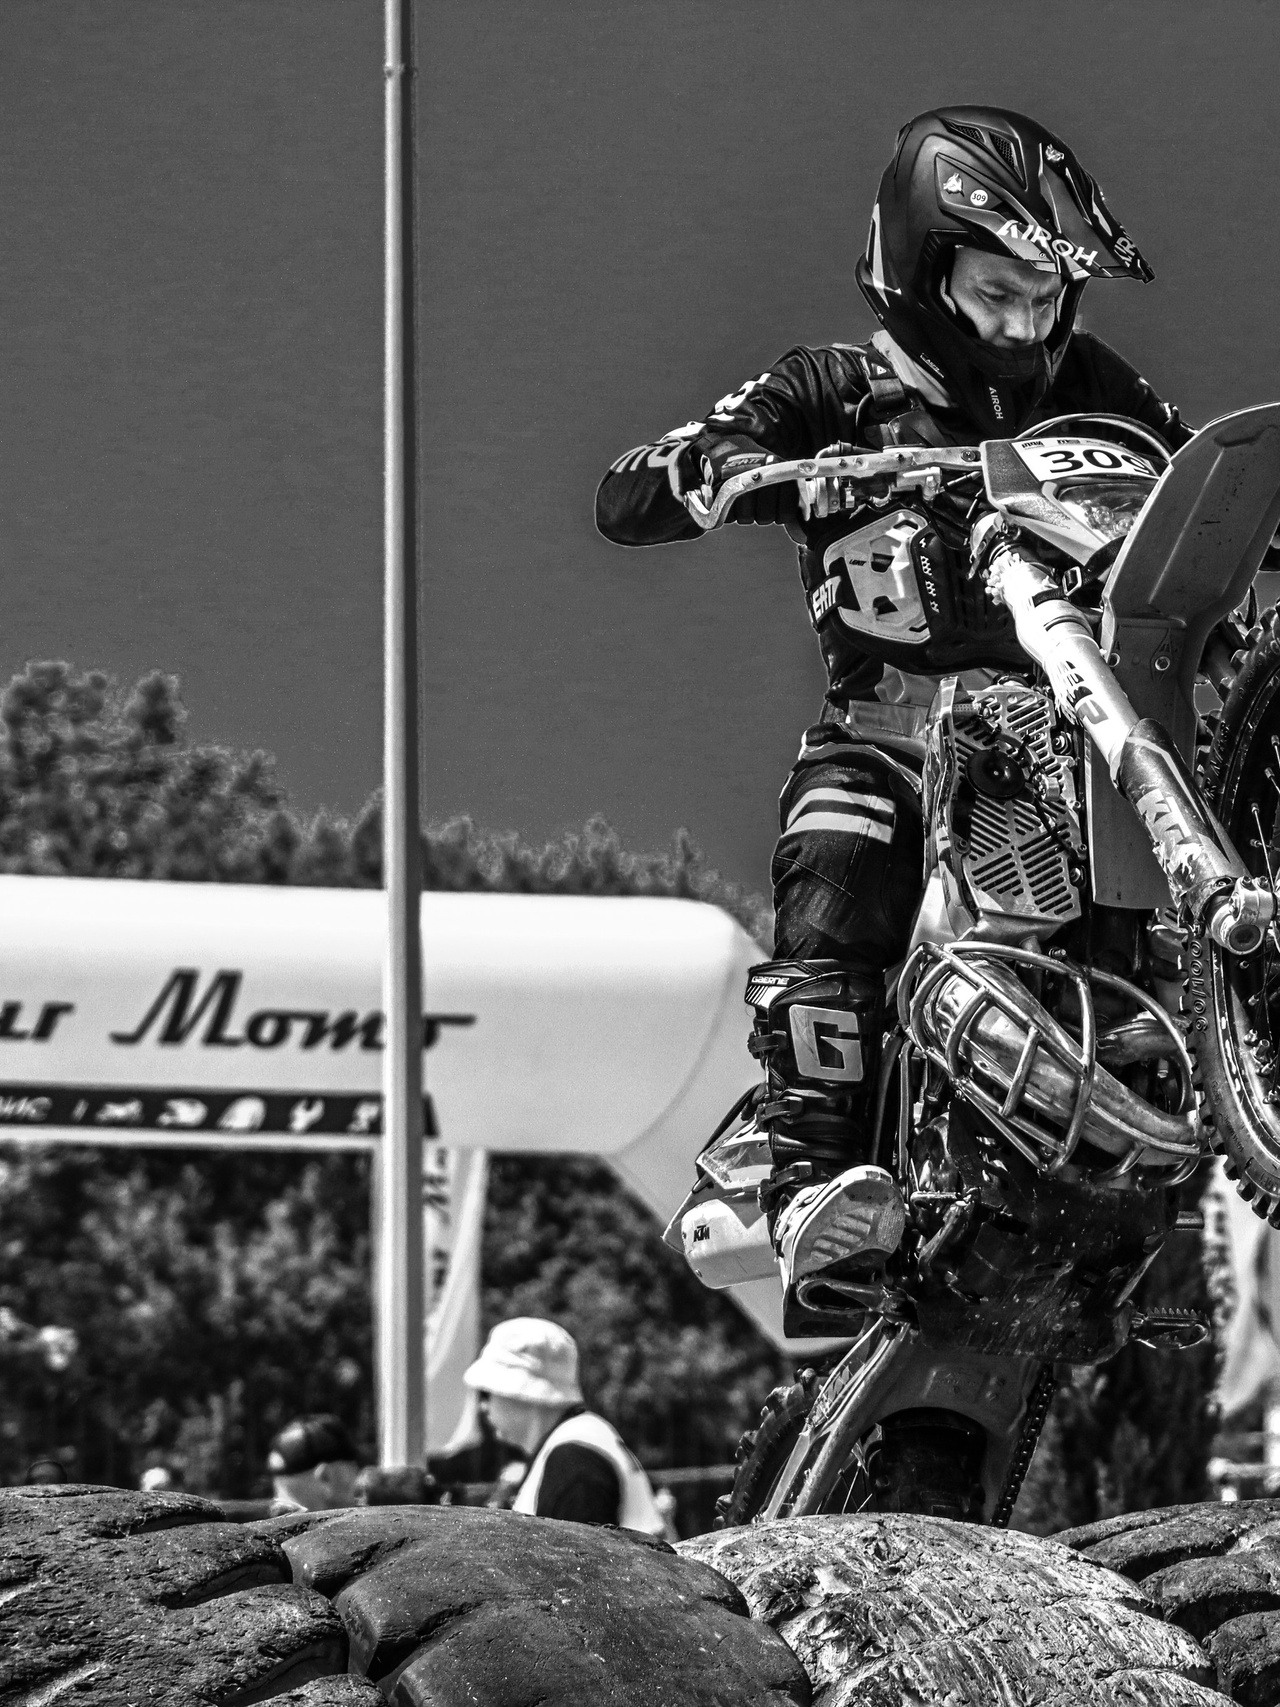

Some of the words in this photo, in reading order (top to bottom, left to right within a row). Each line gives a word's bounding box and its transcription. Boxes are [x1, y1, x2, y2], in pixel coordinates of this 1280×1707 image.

[972, 193, 986, 202] 309
[996, 220, 1098, 267] AIROH
[989, 386, 1004, 419] AIROH
[1040, 449, 1152, 475] 309
[789, 1004, 864, 1082] G
[693, 1224, 710, 1242] KTM
